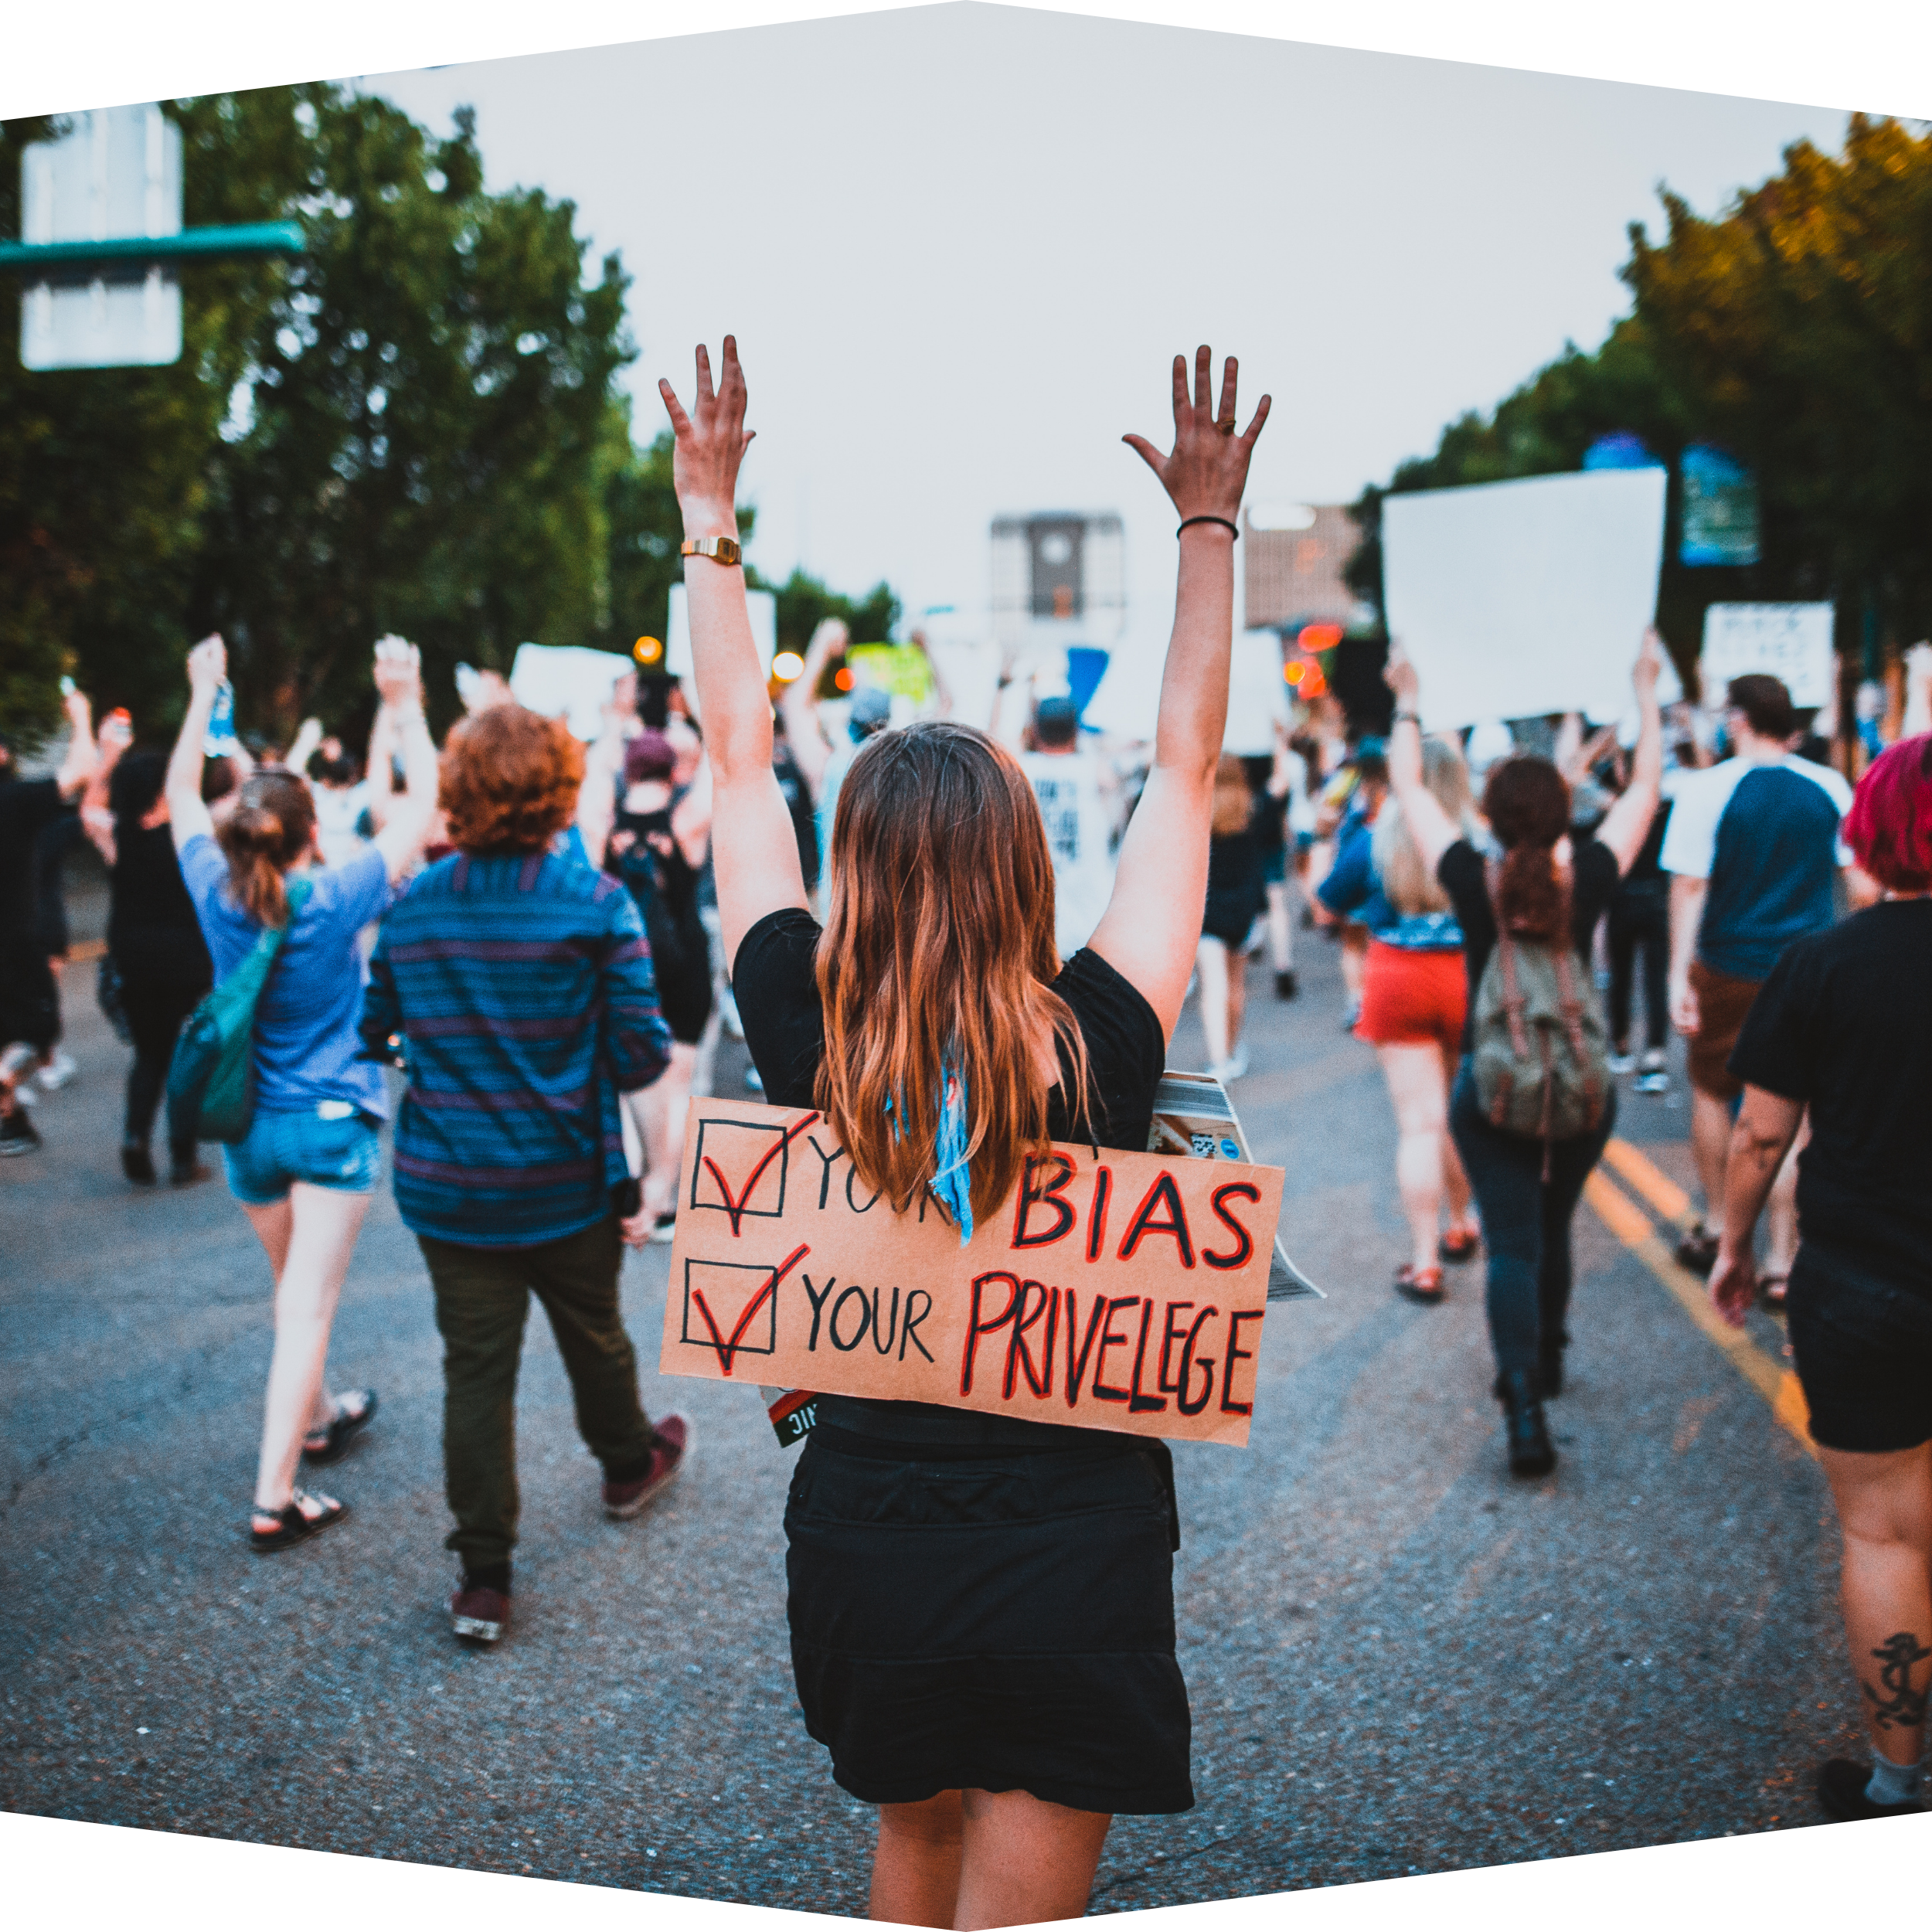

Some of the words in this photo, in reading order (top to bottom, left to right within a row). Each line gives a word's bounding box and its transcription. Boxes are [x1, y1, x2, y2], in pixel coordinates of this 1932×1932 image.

[1009, 1149, 1262, 1271] BIAS
[801, 1274, 935, 1363] YOUR
[960, 1270, 1265, 1417] PRIVELEGE
